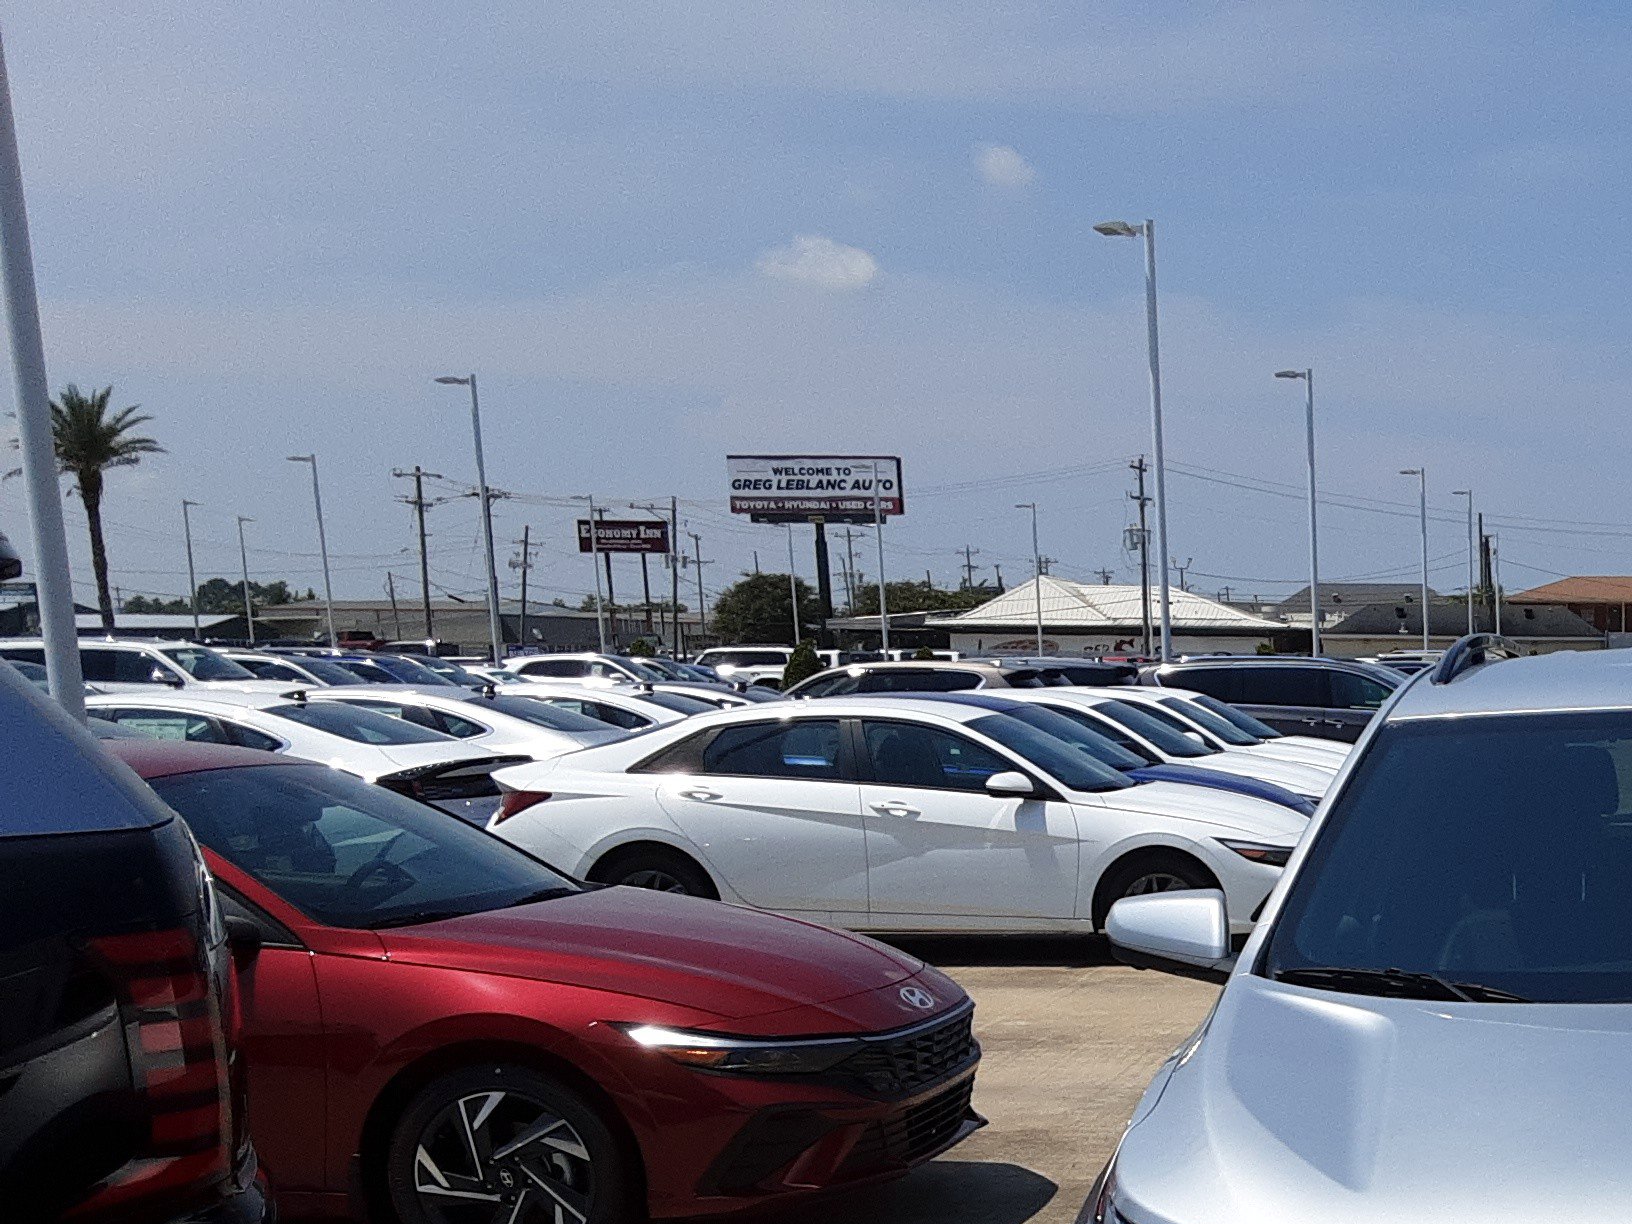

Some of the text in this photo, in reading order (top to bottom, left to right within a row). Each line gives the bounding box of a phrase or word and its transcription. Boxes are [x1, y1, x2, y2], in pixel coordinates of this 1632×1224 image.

[772, 467, 852, 476] WELCOME TO
[732, 479, 773, 491] GREG
[777, 479, 847, 491] LEBLANC
[735, 501, 893, 510] TOYOTA HYUNDAI USED CRS
[580, 524, 638, 538] EONOMY
